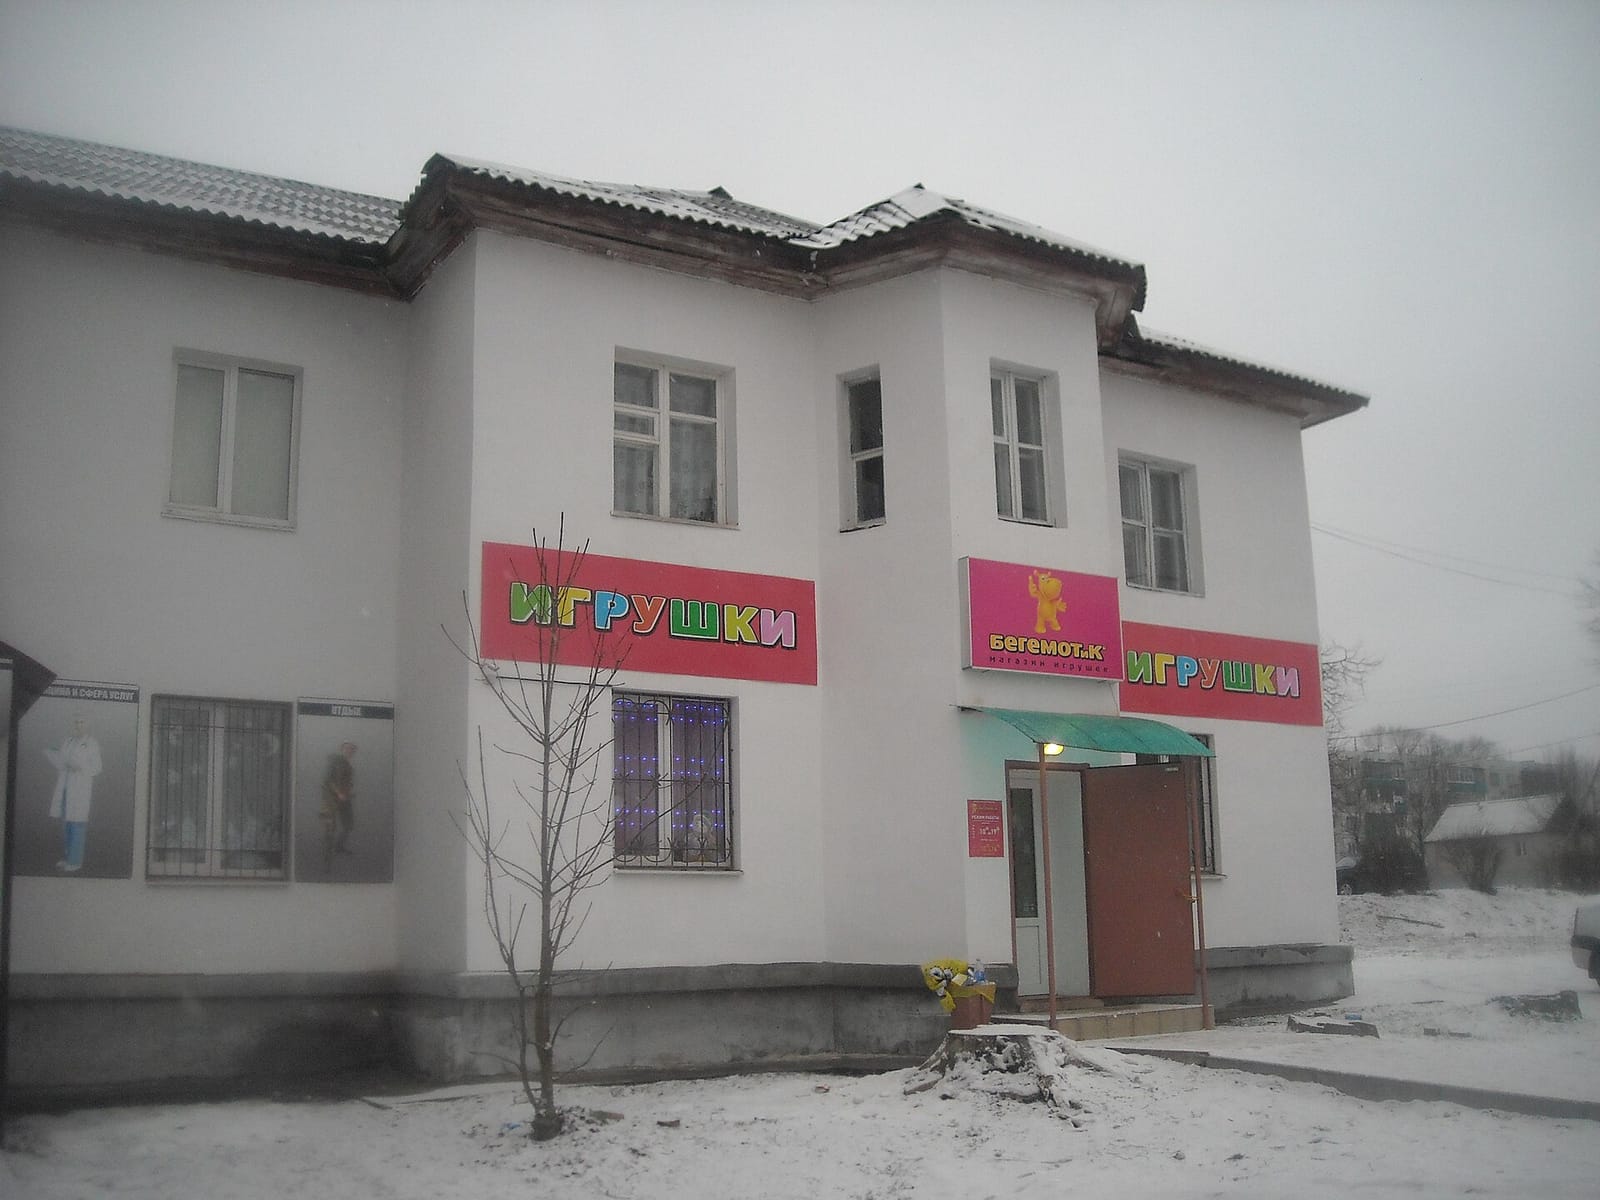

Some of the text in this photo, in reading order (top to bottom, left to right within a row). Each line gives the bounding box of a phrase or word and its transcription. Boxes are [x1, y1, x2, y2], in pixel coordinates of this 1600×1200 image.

[509, 582, 796, 648] ИГРУШКИ
[79, 688, 108, 699] СФЕРА
[109, 691, 135, 701] УСЛУГ
[1126, 650, 1300, 698] ИГРУШКИ
